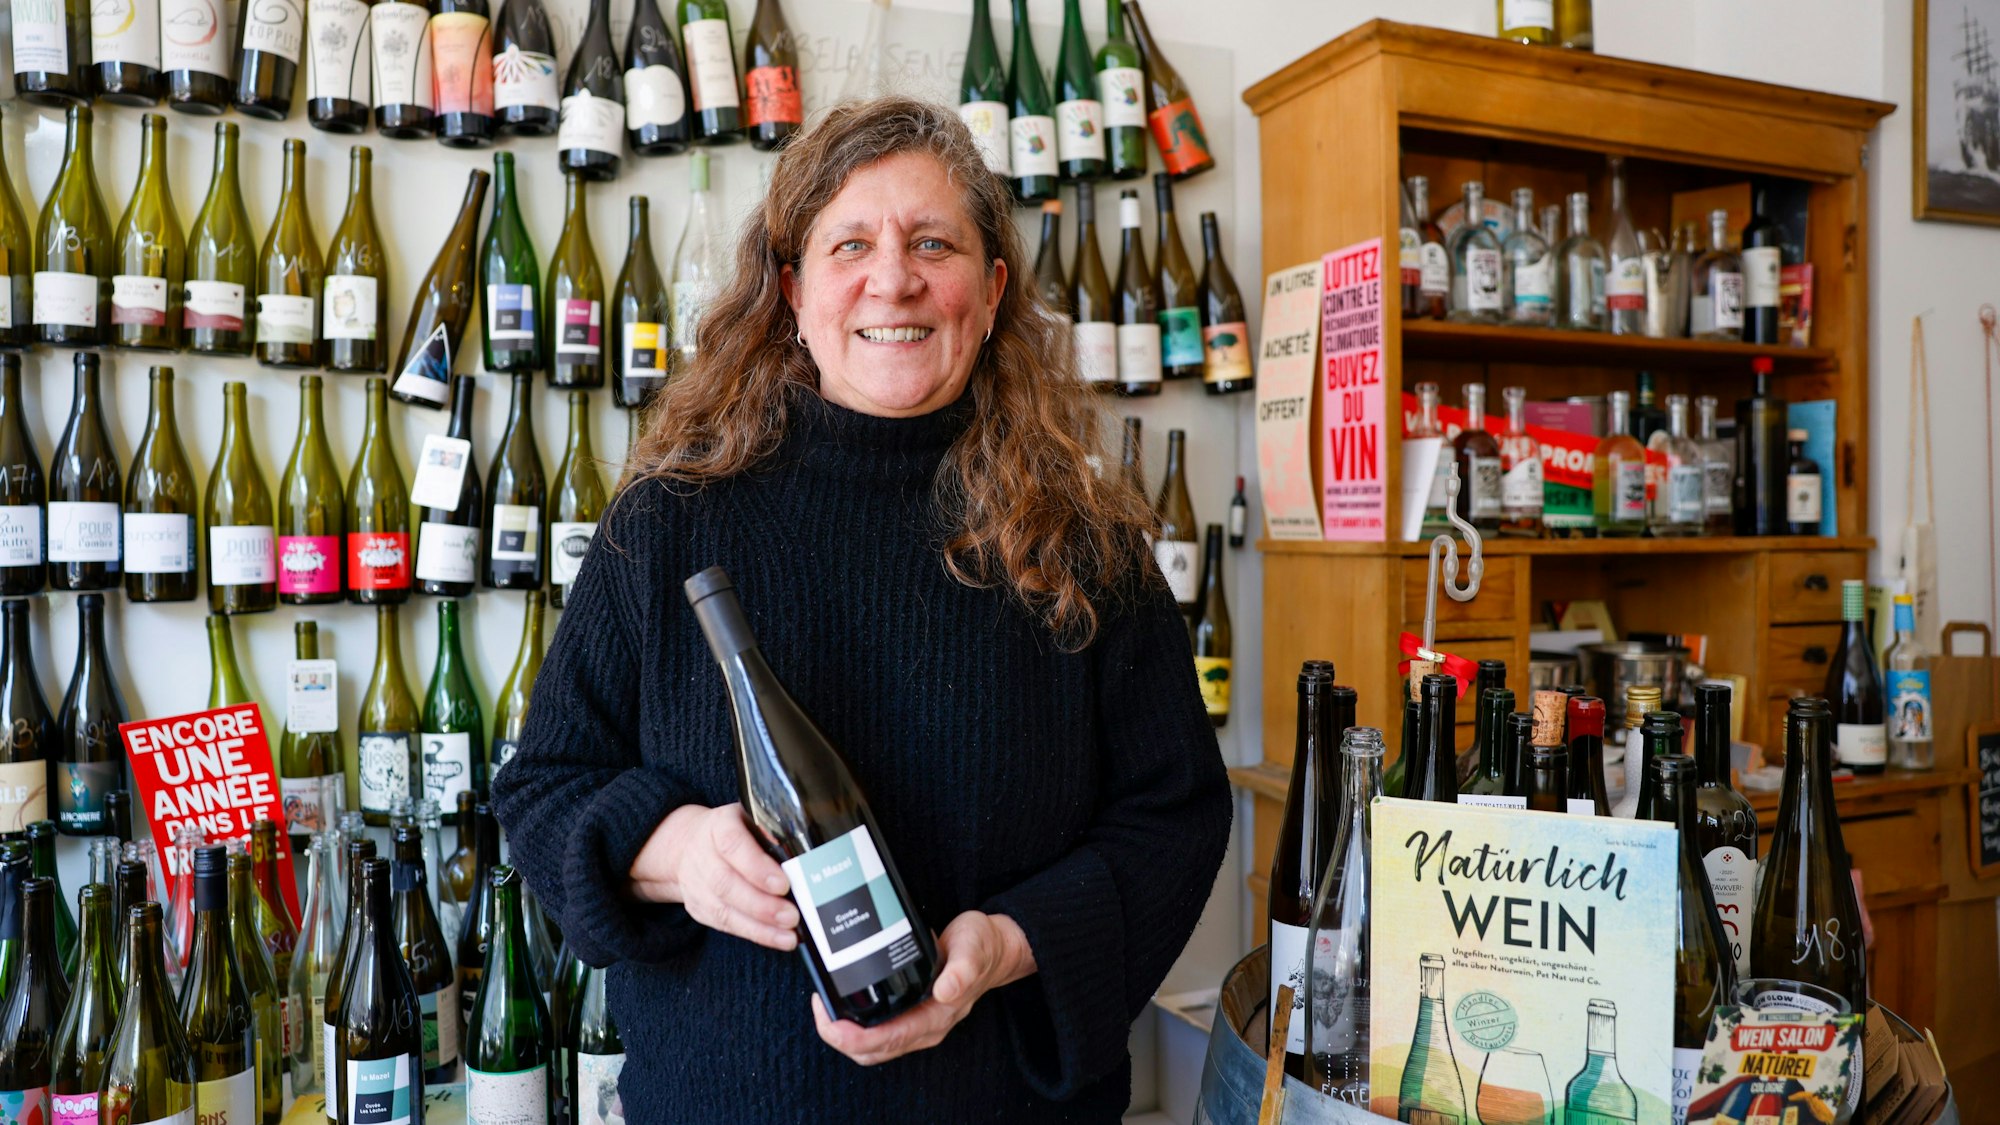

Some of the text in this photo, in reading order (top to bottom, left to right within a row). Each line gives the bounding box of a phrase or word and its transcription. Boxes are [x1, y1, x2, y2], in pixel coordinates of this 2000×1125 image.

[1285, 268, 1316, 293] LITRE
[1324, 246, 1379, 291] LUTTEZ
[1324, 287, 1364, 315] CONTRE
[1367, 281, 1379, 305] LE
[1264, 328, 1311, 360] ACHETÉ
[1327, 351, 1380, 391] BUVEZ
[1259, 396, 1305, 422] OFFERT
[1343, 390, 1364, 423] DU
[1330, 424, 1378, 482] VIN
[78, 521, 113, 535] POUR
[127, 709, 260, 755] ENCORE
[153, 737, 253, 786] UNE
[153, 772, 276, 821] ANNÉE
[1405, 829, 1629, 902] Natürlich
[1441, 889, 1596, 956] WEIN
[1451, 947, 1497, 961] Ungefiltert,
[1499, 954, 1540, 967] ungeklärt,
[1451, 960, 1602, 986] alles über Naturwein, Pet Nat und Co.
[1467, 1016, 1500, 1028] Winzer
[1737, 1026, 1827, 1048] WEIN SALON
[369, 1071, 390, 1081] Mazel
